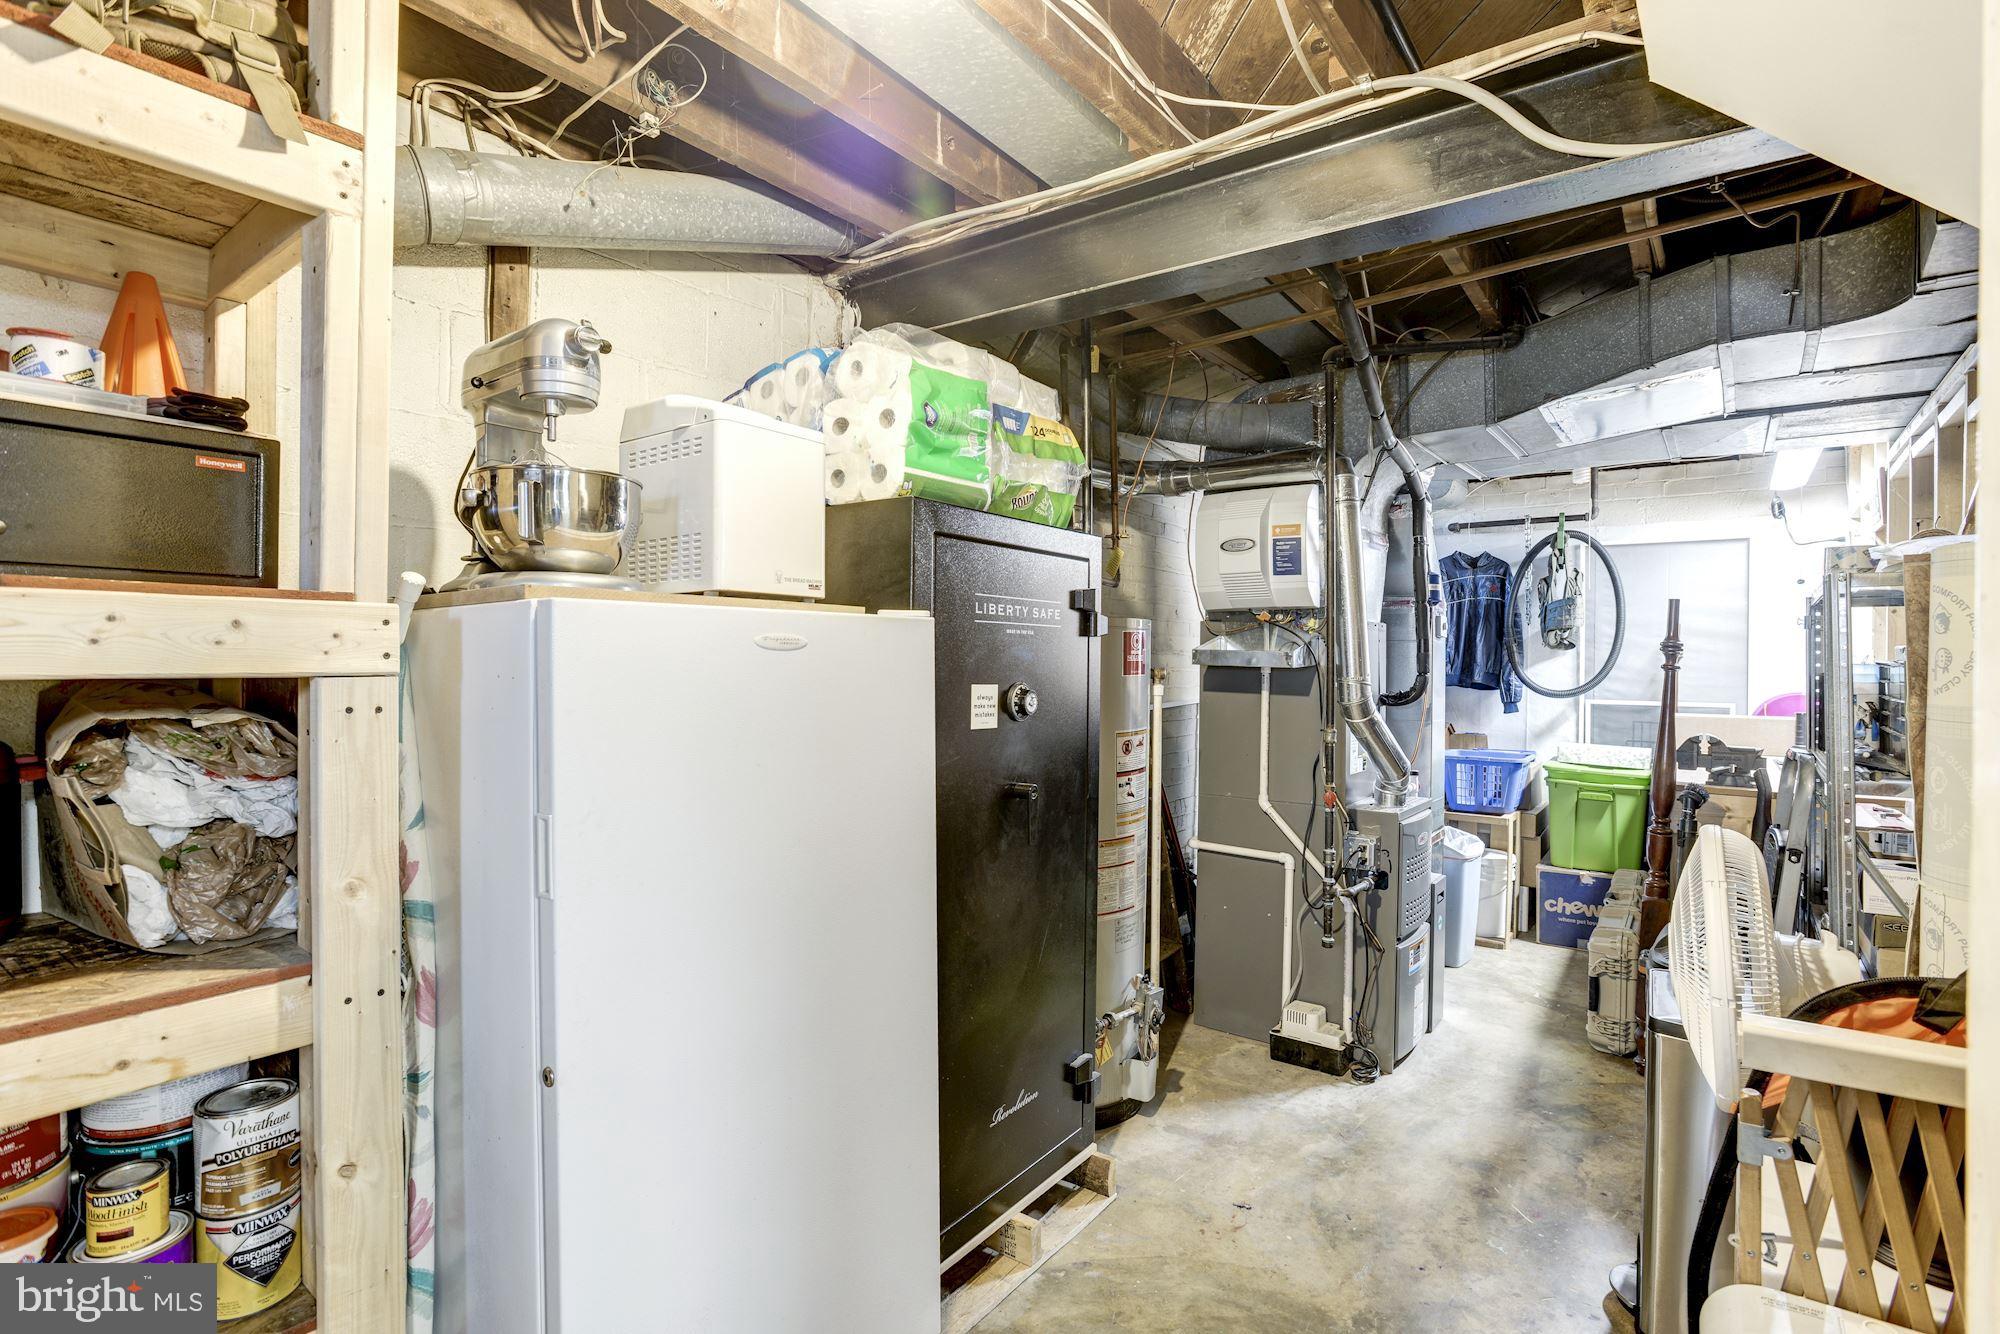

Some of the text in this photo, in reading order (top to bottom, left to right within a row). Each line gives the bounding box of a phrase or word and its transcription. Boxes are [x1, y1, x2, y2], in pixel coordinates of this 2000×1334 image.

[13, 346, 35, 362] Scotch
[66, 369, 93, 382] Scotch
[200, 458, 243, 469] Honeywell
[1933, 585, 1971, 613] COMFORT
[975, 602, 1061, 619] LIBERTY SAFE
[1933, 675, 1961, 696] CLEAN
[977, 693, 993, 701] always
[1544, 897, 1604, 917] chew
[1923, 896, 1961, 939] COMFORT
[1883, 922, 1909, 932] KEE
[989, 1089, 1039, 1128] Revolution
[223, 1111, 291, 1138] Varathane
[236, 1129, 282, 1147] ULTIMATE
[216, 1131, 296, 1165] POLYURETHANE
[94, 1191, 140, 1207] MINWAX
[252, 1189, 272, 1199] SATIN
[236, 1206, 289, 1234] MINWAX
[232, 1233, 293, 1265] PERFORMANCE
[249, 1250, 281, 1268] SERIES
